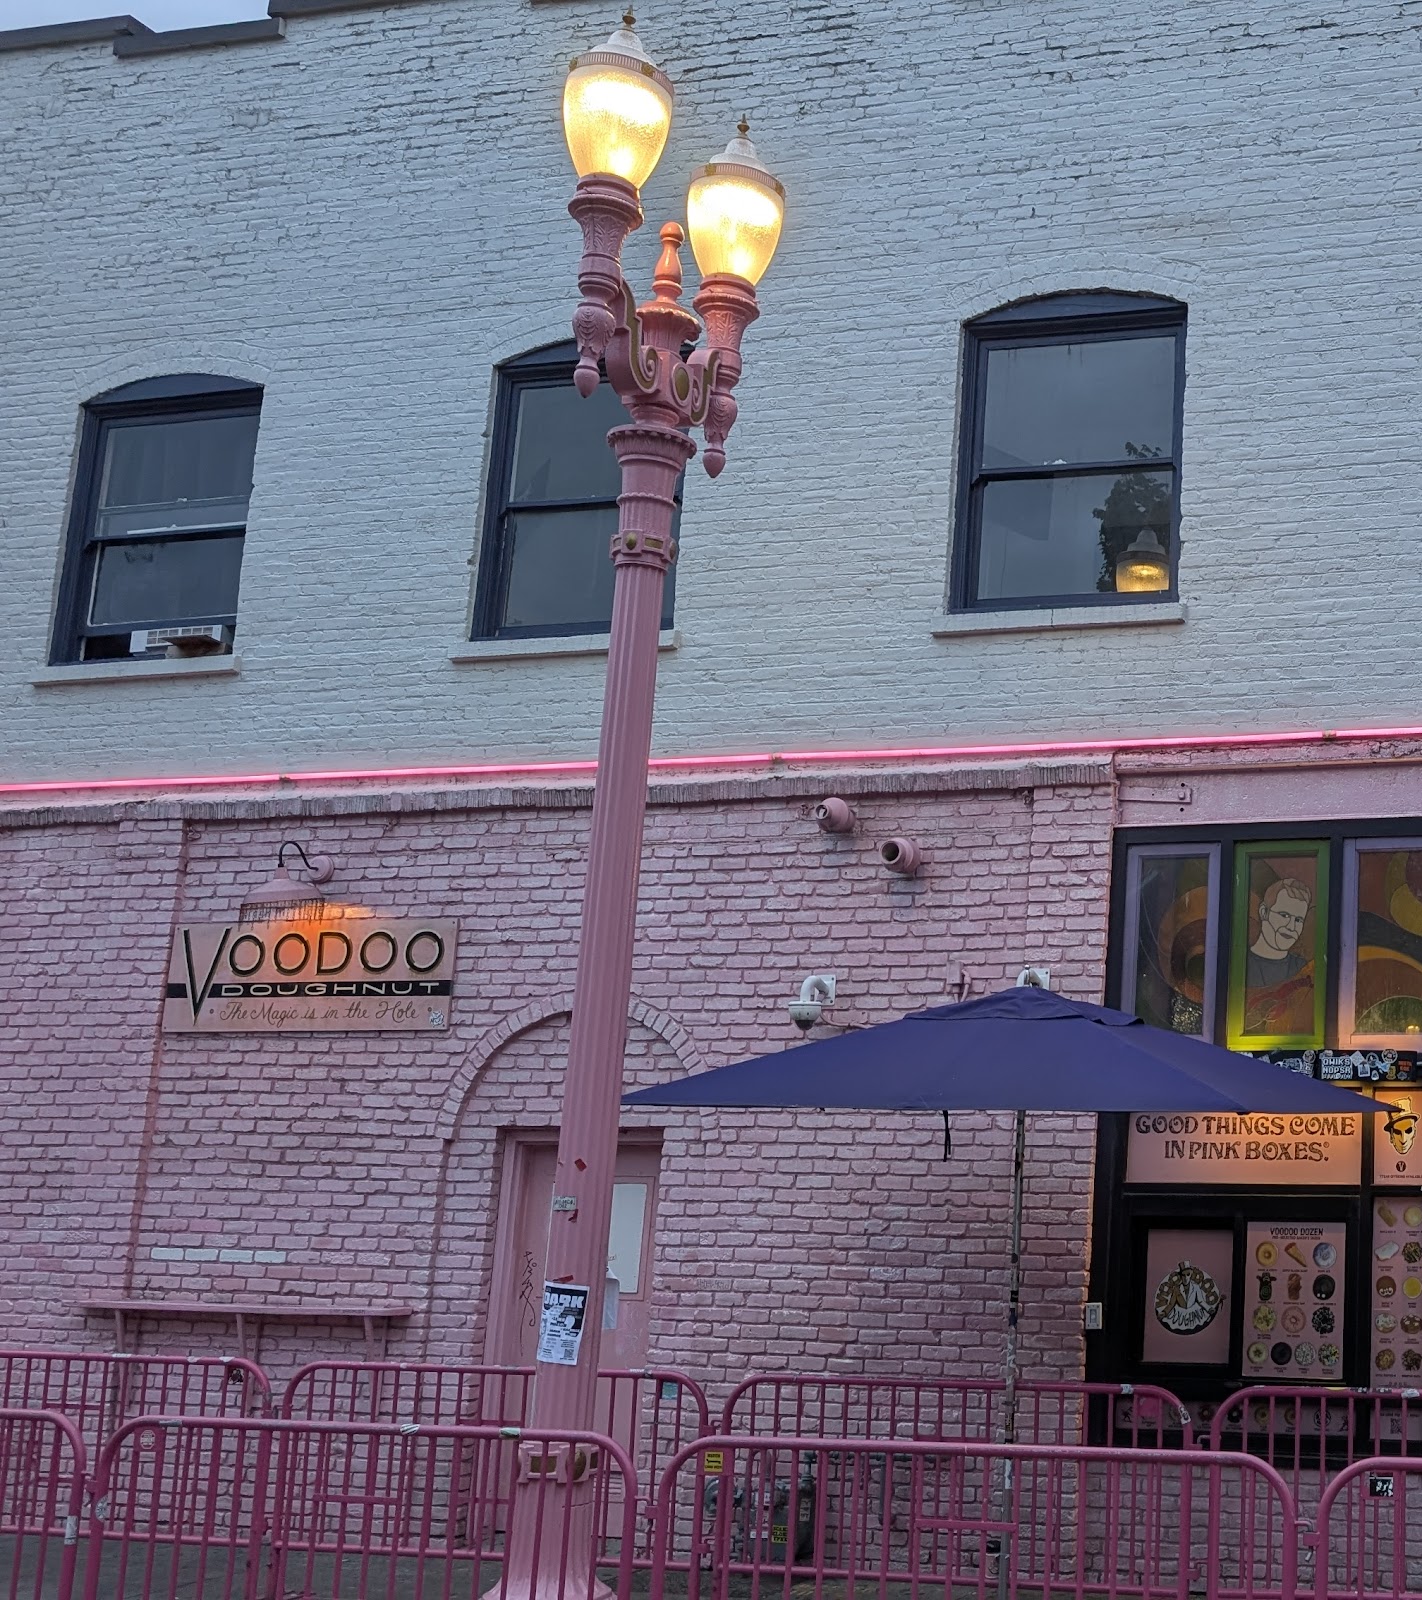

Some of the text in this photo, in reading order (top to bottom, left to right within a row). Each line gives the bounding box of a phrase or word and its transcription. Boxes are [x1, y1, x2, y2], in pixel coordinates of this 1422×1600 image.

[183, 927, 445, 1026] VOODOO
[221, 981, 439, 997] DOUGHNUT
[219, 1001, 249, 1021] The
[249, 1001, 298, 1028] Magic
[301, 1005, 318, 1020] is
[321, 1005, 340, 1020] in
[343, 1000, 371, 1019] the
[375, 1000, 420, 1024] Hole
[1135, 1115, 1356, 1136] GOOD THINGS COME
[1164, 1140, 1186, 1160] IN
[1189, 1141, 1241, 1160] PINK
[1270, 1227, 1324, 1236] VOODOO DOZEN
[544, 1292, 585, 1308] DARK
